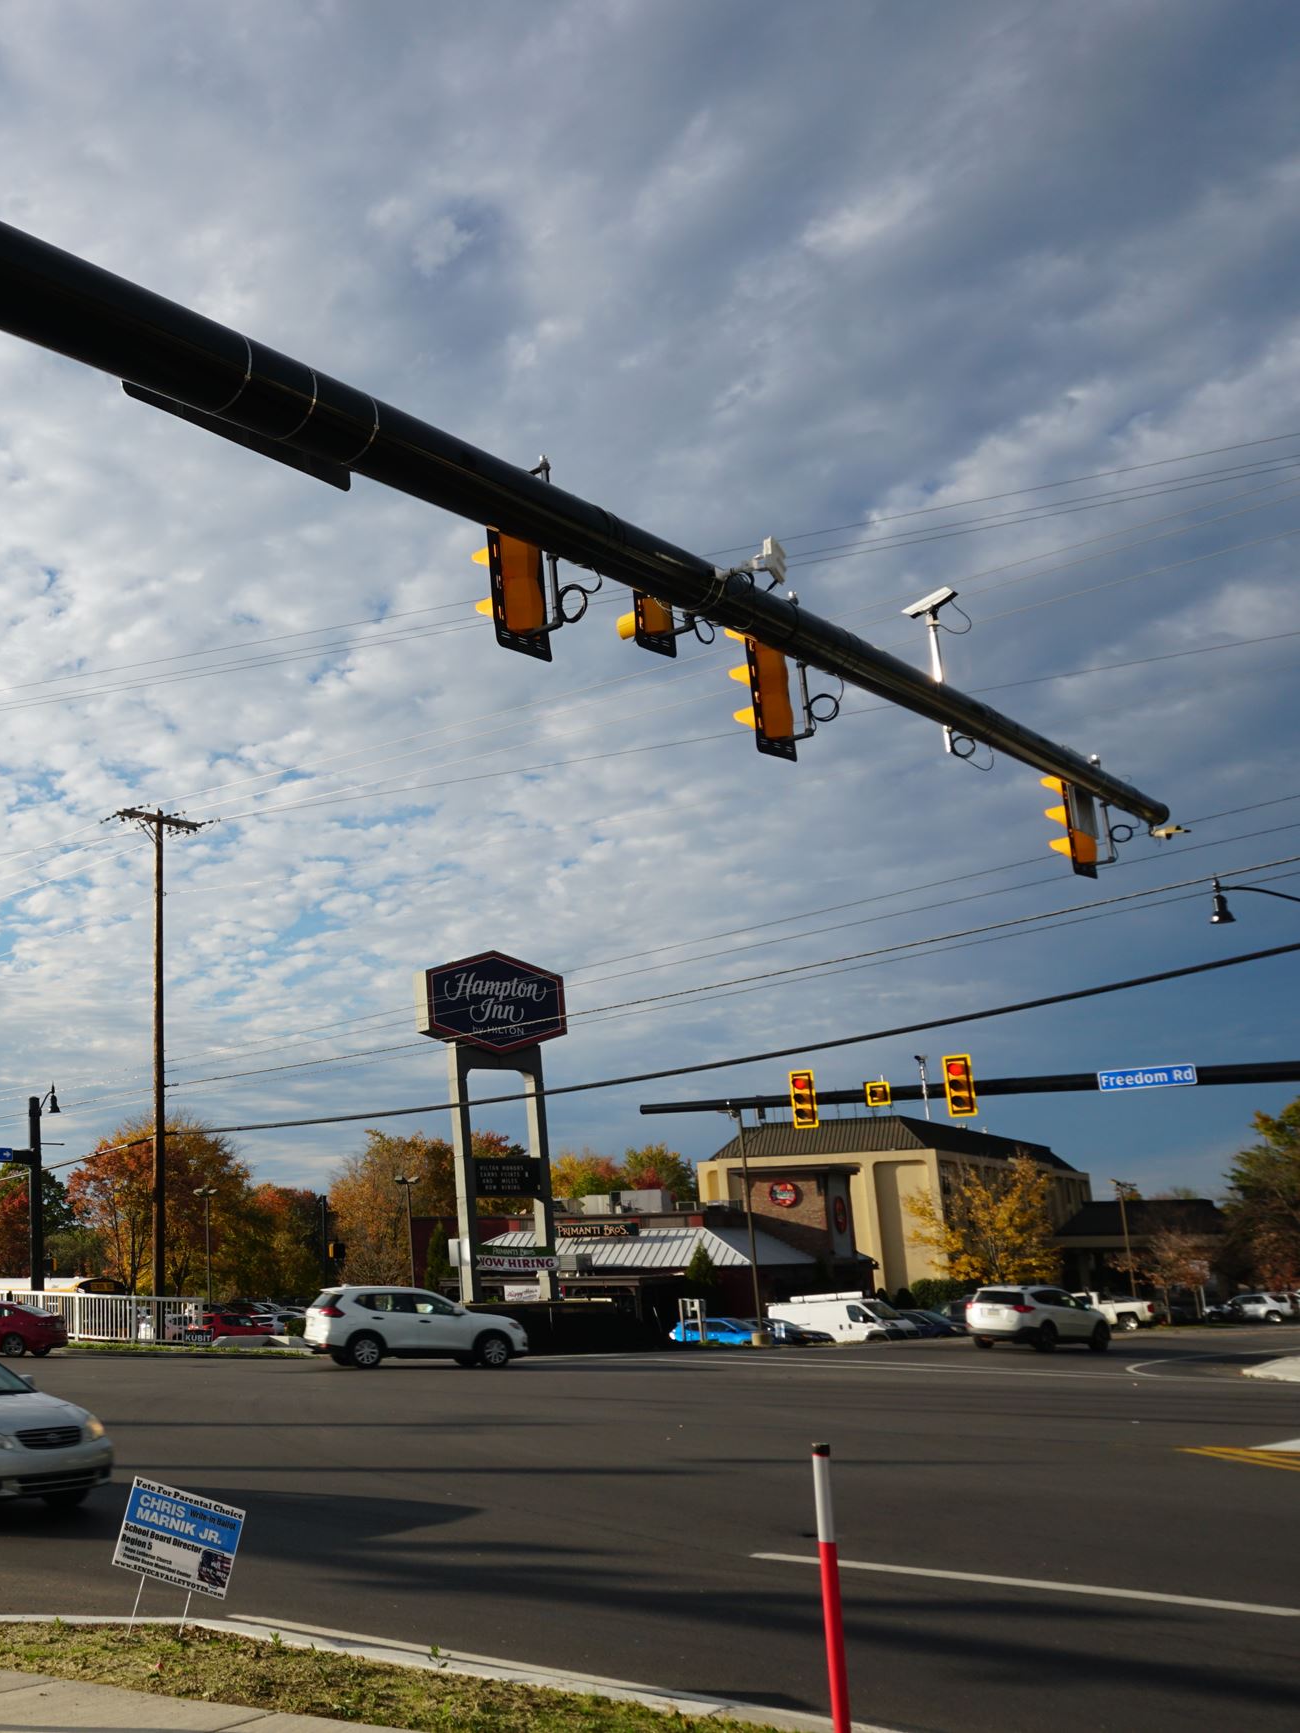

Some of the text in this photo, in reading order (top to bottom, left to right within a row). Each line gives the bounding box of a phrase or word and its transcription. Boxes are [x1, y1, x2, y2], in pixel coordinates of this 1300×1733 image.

[444, 972, 546, 1001] Hampton
[469, 998, 524, 1023] Inn
[1101, 1068, 1193, 1087] Freedom Rd
[555, 1225, 600, 1237] PRIMANTI
[508, 1258, 554, 1268] HIRING
[185, 1334, 211, 1342] KUBIT
[135, 1479, 243, 1520] Vote For Parental Choice
[139, 1494, 186, 1518] CHRIS
[136, 1507, 222, 1544] MARNIK JR.
[121, 1533, 153, 1550] Region 5
[124, 1522, 202, 1554] School Board Director
